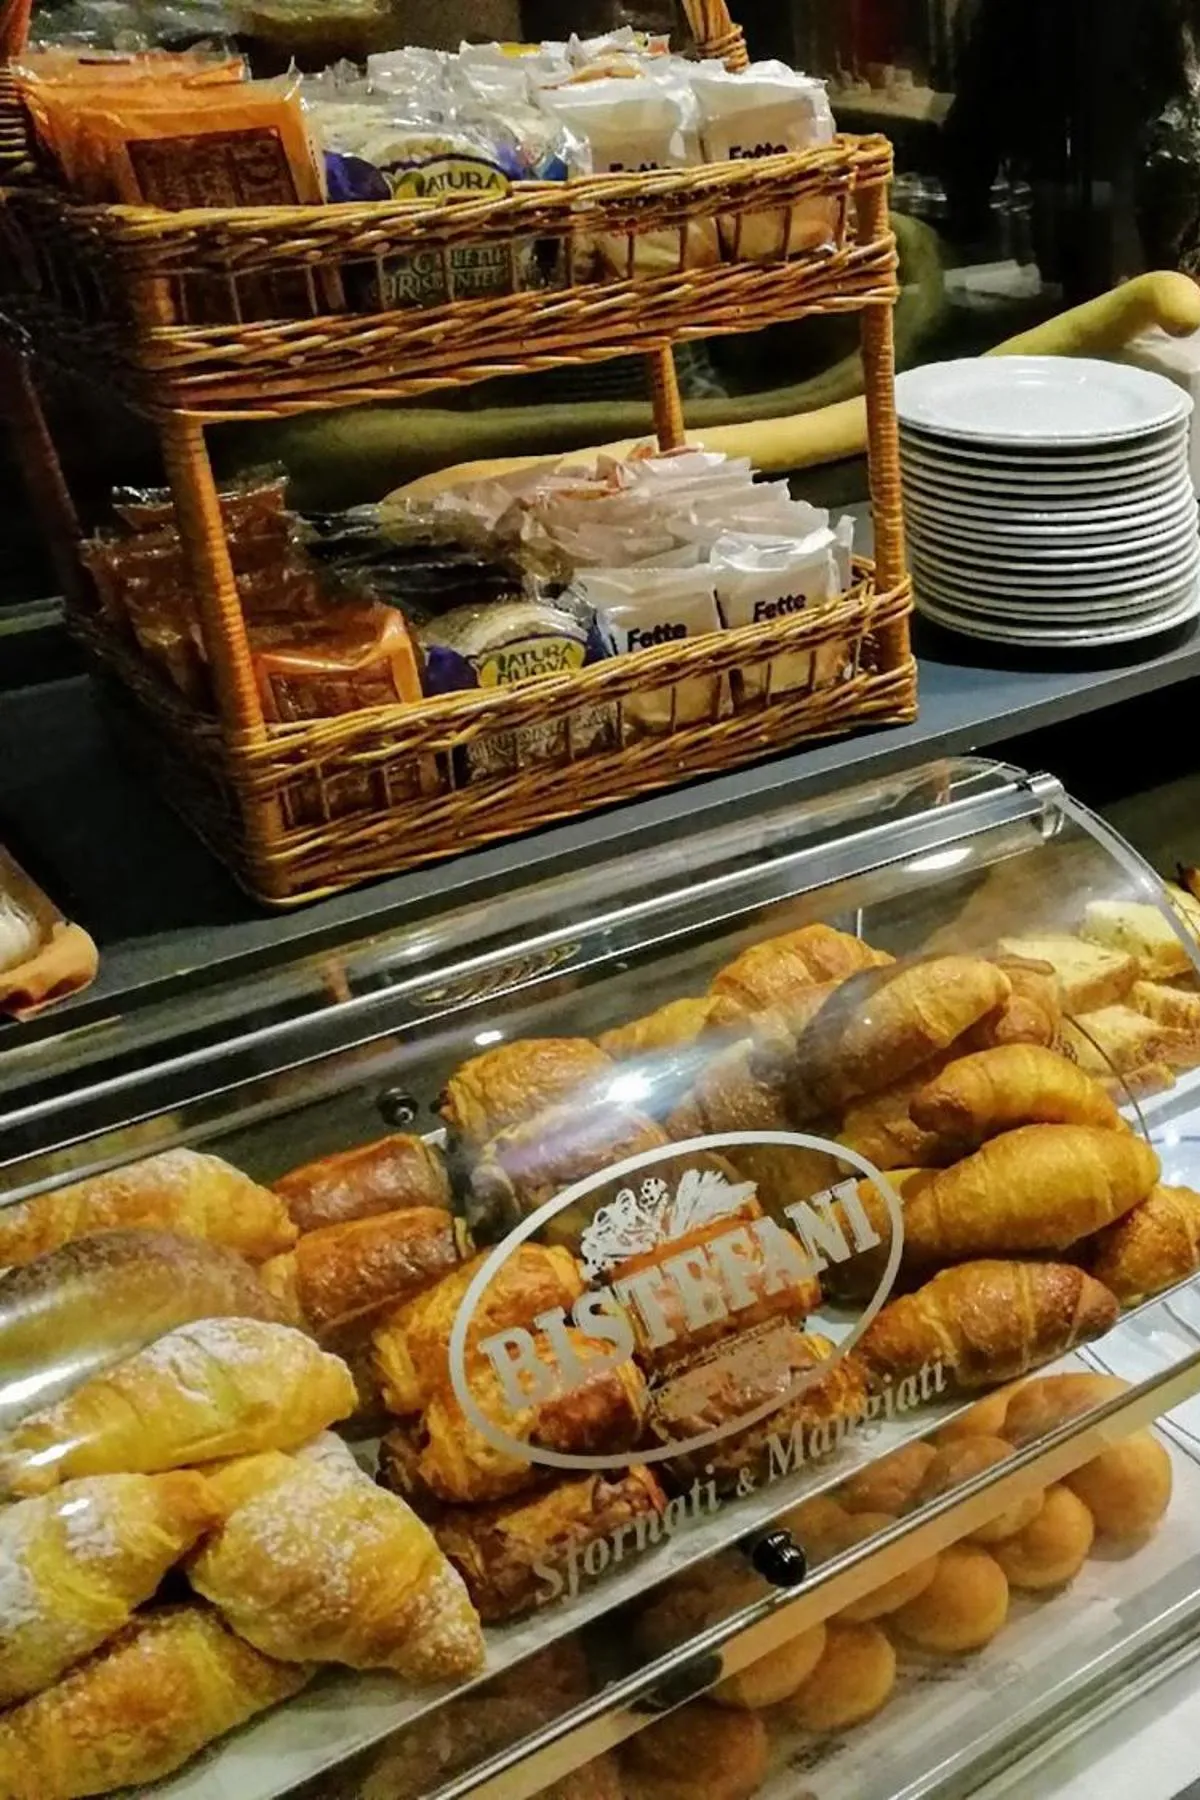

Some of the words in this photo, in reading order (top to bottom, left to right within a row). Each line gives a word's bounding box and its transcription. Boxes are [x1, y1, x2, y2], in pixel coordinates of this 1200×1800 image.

[626, 622, 688, 652] Fette
[752, 592, 807, 623] Fette
[479, 1176, 882, 1411] BISTEFANI
[531, 1460, 722, 1602] Sfornati
[734, 1467, 757, 1496] &
[764, 1355, 948, 1482] Mangiati
